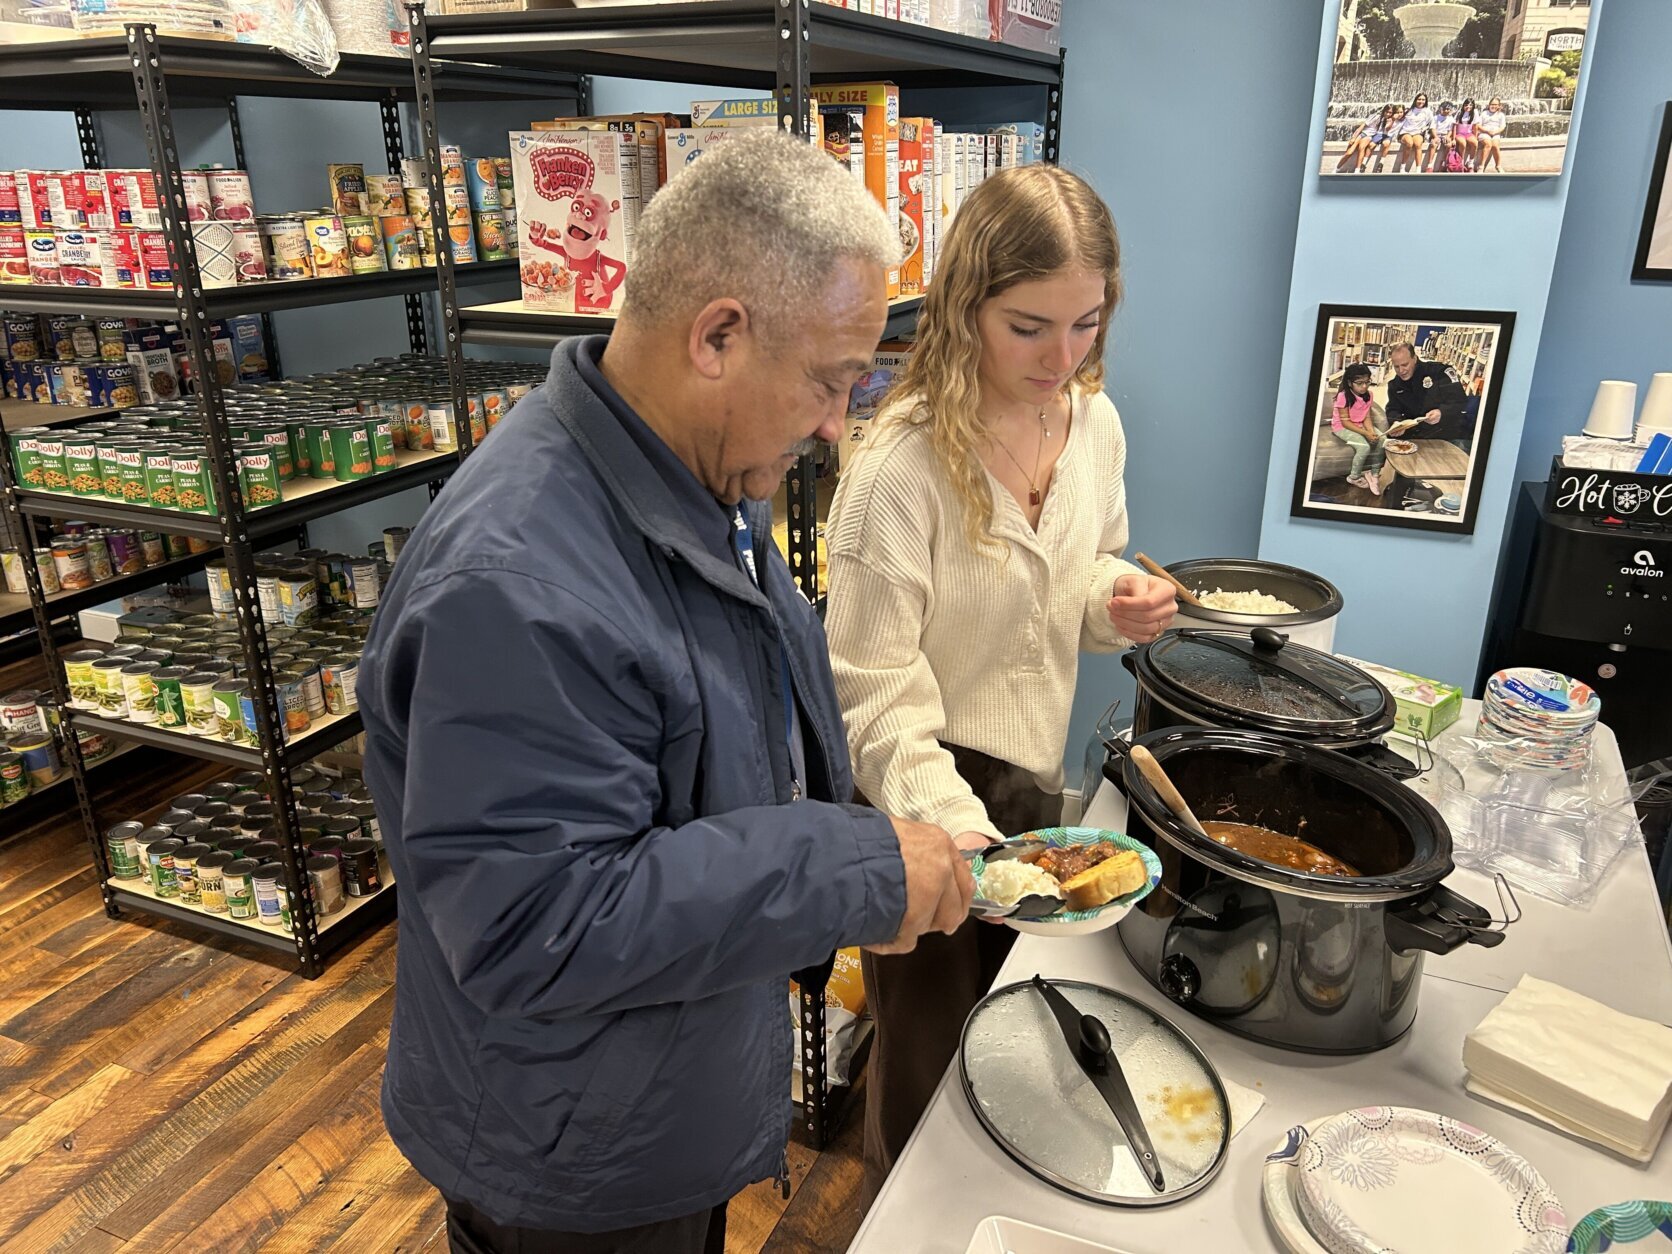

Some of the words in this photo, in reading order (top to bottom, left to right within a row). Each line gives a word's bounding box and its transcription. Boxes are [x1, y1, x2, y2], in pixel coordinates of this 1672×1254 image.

[838, 90, 868, 102] SIZE
[724, 101, 759, 116] LARGE
[762, 100, 778, 114] SIZ
[537, 157, 588, 177] Franken
[899, 159, 919, 172] EAT
[547, 172, 585, 191] Berry
[53, 321, 67, 331] GO
[100, 321, 124, 331] GOYA
[147, 357, 169, 366] BROTH
[875, 357, 894, 366] FOOD
[107, 367, 132, 377] GOYA
[67, 447, 94, 459] Dolly
[172, 461, 200, 473] Dolly
[243, 457, 269, 468] Dolly
[1556, 474, 1612, 512] Hot
[1620, 566, 1664, 578] avalon
[201, 880, 221, 892] ORN
[1161, 883, 1192, 908] Hamilton
[1192, 904, 1217, 922] Beach
